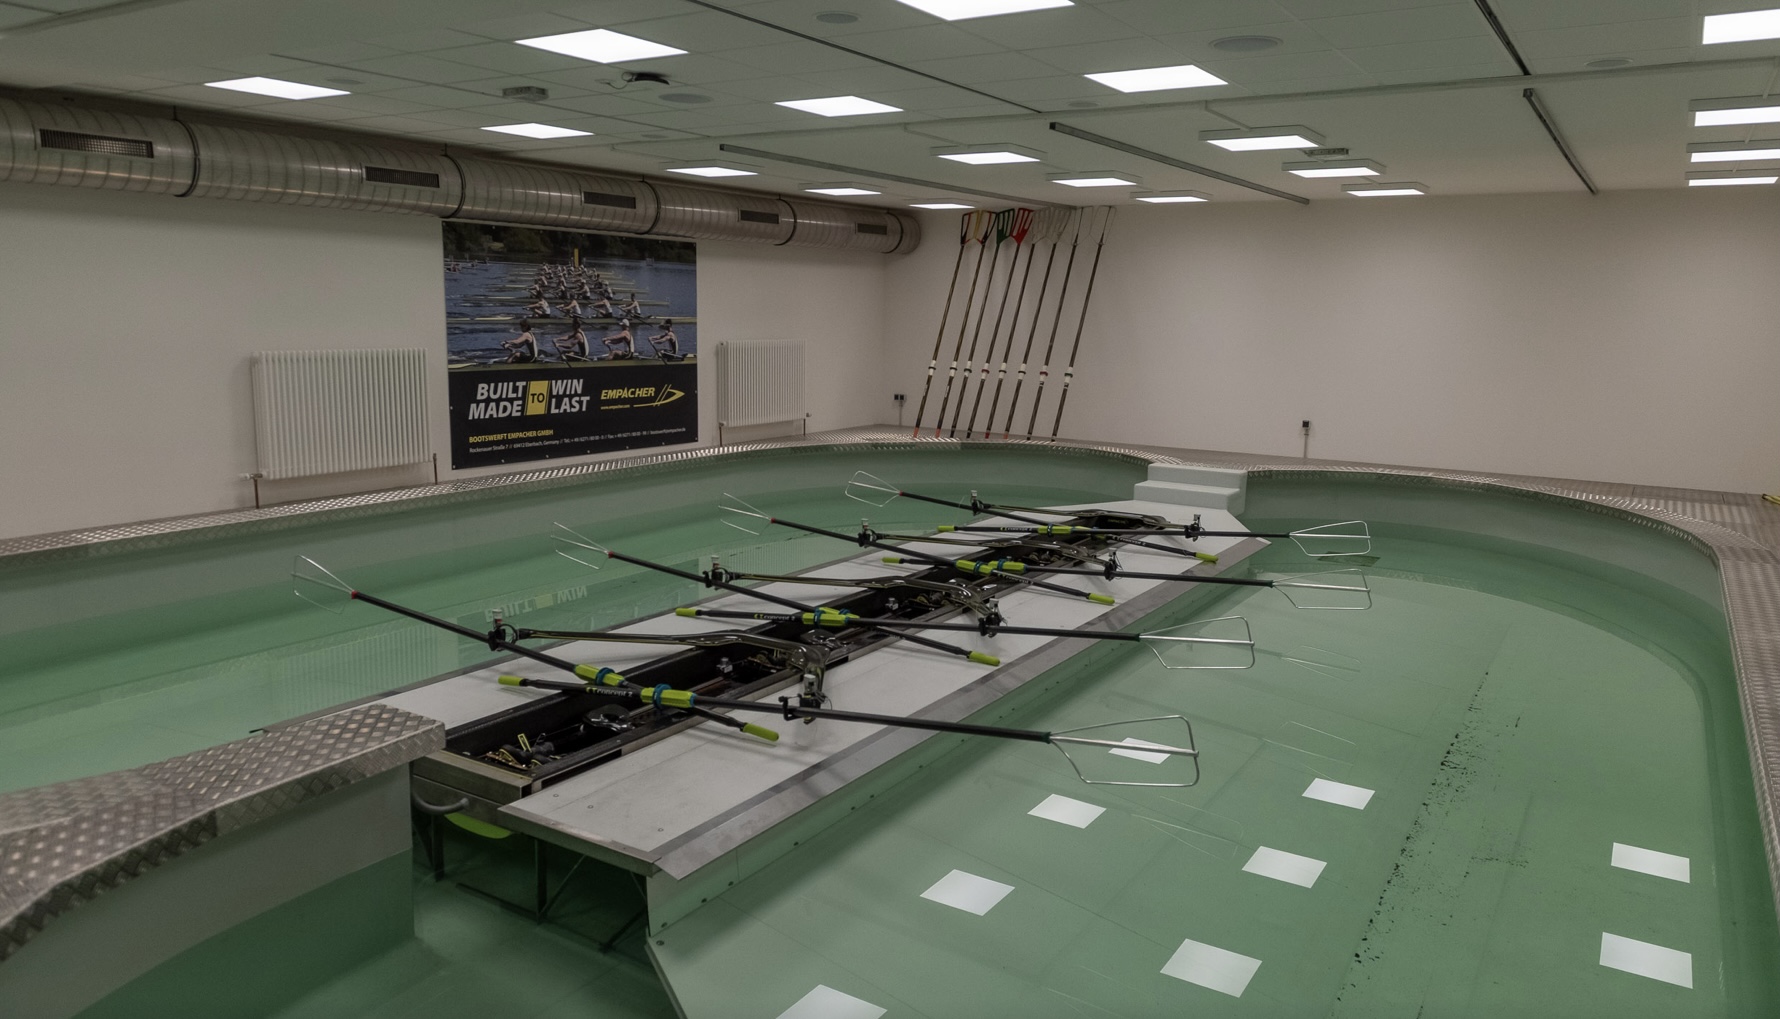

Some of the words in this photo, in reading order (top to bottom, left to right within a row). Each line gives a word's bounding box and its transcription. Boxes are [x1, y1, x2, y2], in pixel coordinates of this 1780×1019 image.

[476, 381, 527, 400] BUILT
[530, 393, 545, 403] TO
[551, 379, 584, 396] WIN
[600, 387, 656, 400] EMPACHER
[468, 400, 523, 420] MADE
[550, 396, 590, 414] LAST
[469, 433, 507, 443] BOOTSWERFT
[508, 430, 537, 439] EMPACHER
